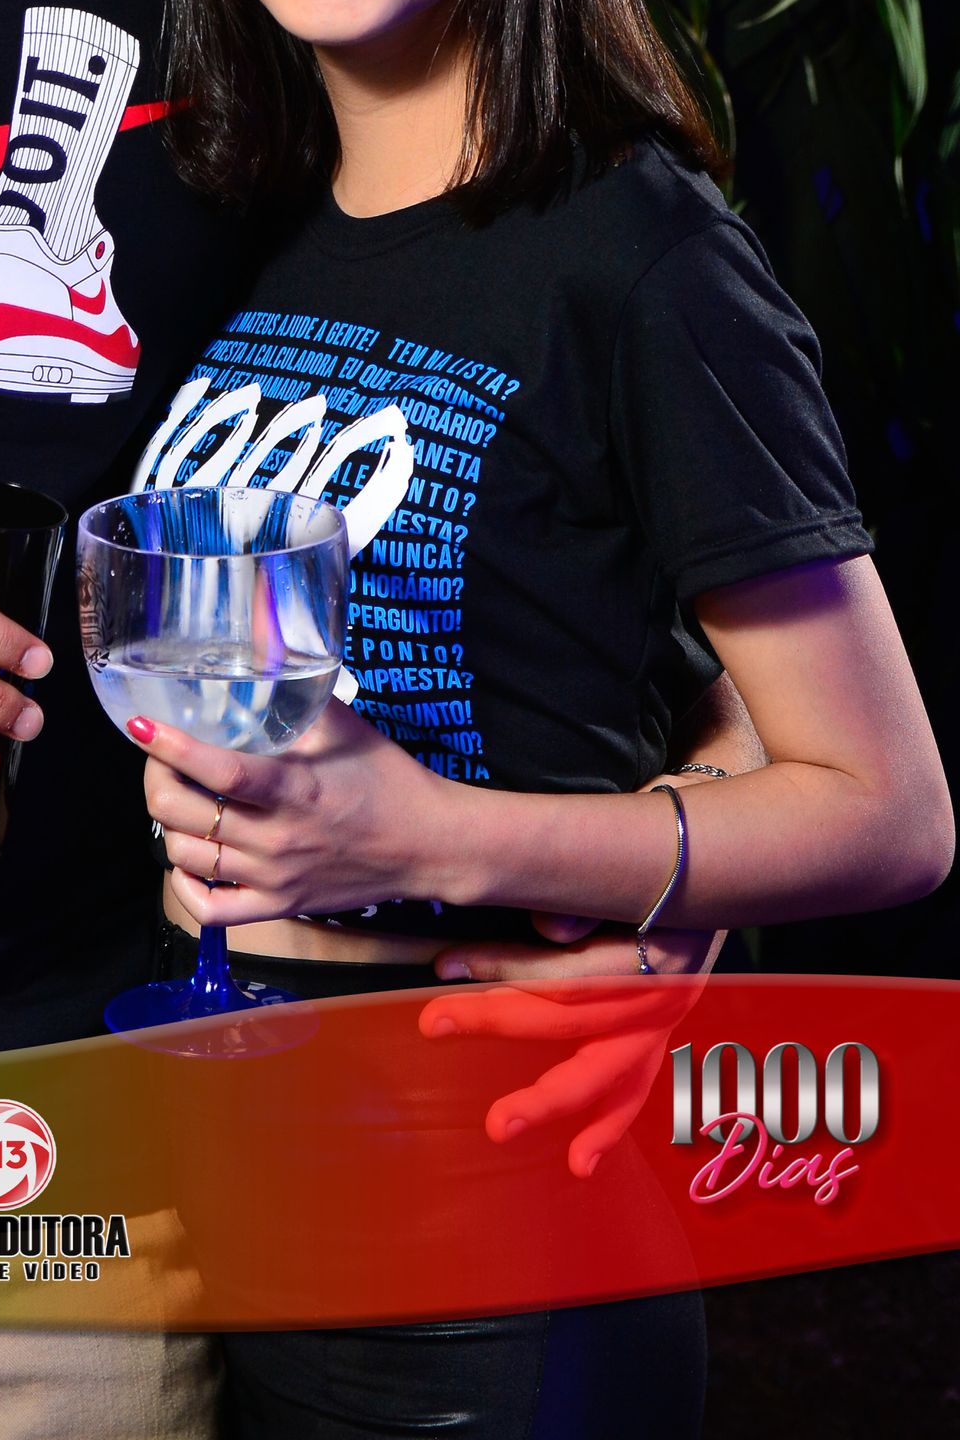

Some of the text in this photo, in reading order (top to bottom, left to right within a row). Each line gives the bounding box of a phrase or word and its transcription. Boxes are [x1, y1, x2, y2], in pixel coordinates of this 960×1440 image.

[243, 343, 258, 365] A
[252, 344, 339, 378] CALCULADORA
[338, 356, 364, 380] EU
[358, 364, 398, 391] QUE
[275, 314, 320, 340] AJUDE
[313, 319, 328, 342] A
[325, 321, 381, 353] GENTE!
[388, 337, 429, 367] TEM
[423, 349, 453, 371] NA
[446, 357, 520, 401] LISTA?
[400, 396, 497, 448] HORÁRIO?
[407, 477, 477, 517] NTO?
[362, 571, 464, 601] HORÁRIO?
[348, 602, 461, 634] PERGUNTO!
[362, 637, 464, 667] PONTO?
[352, 698, 473, 728] PERGUNTO!
